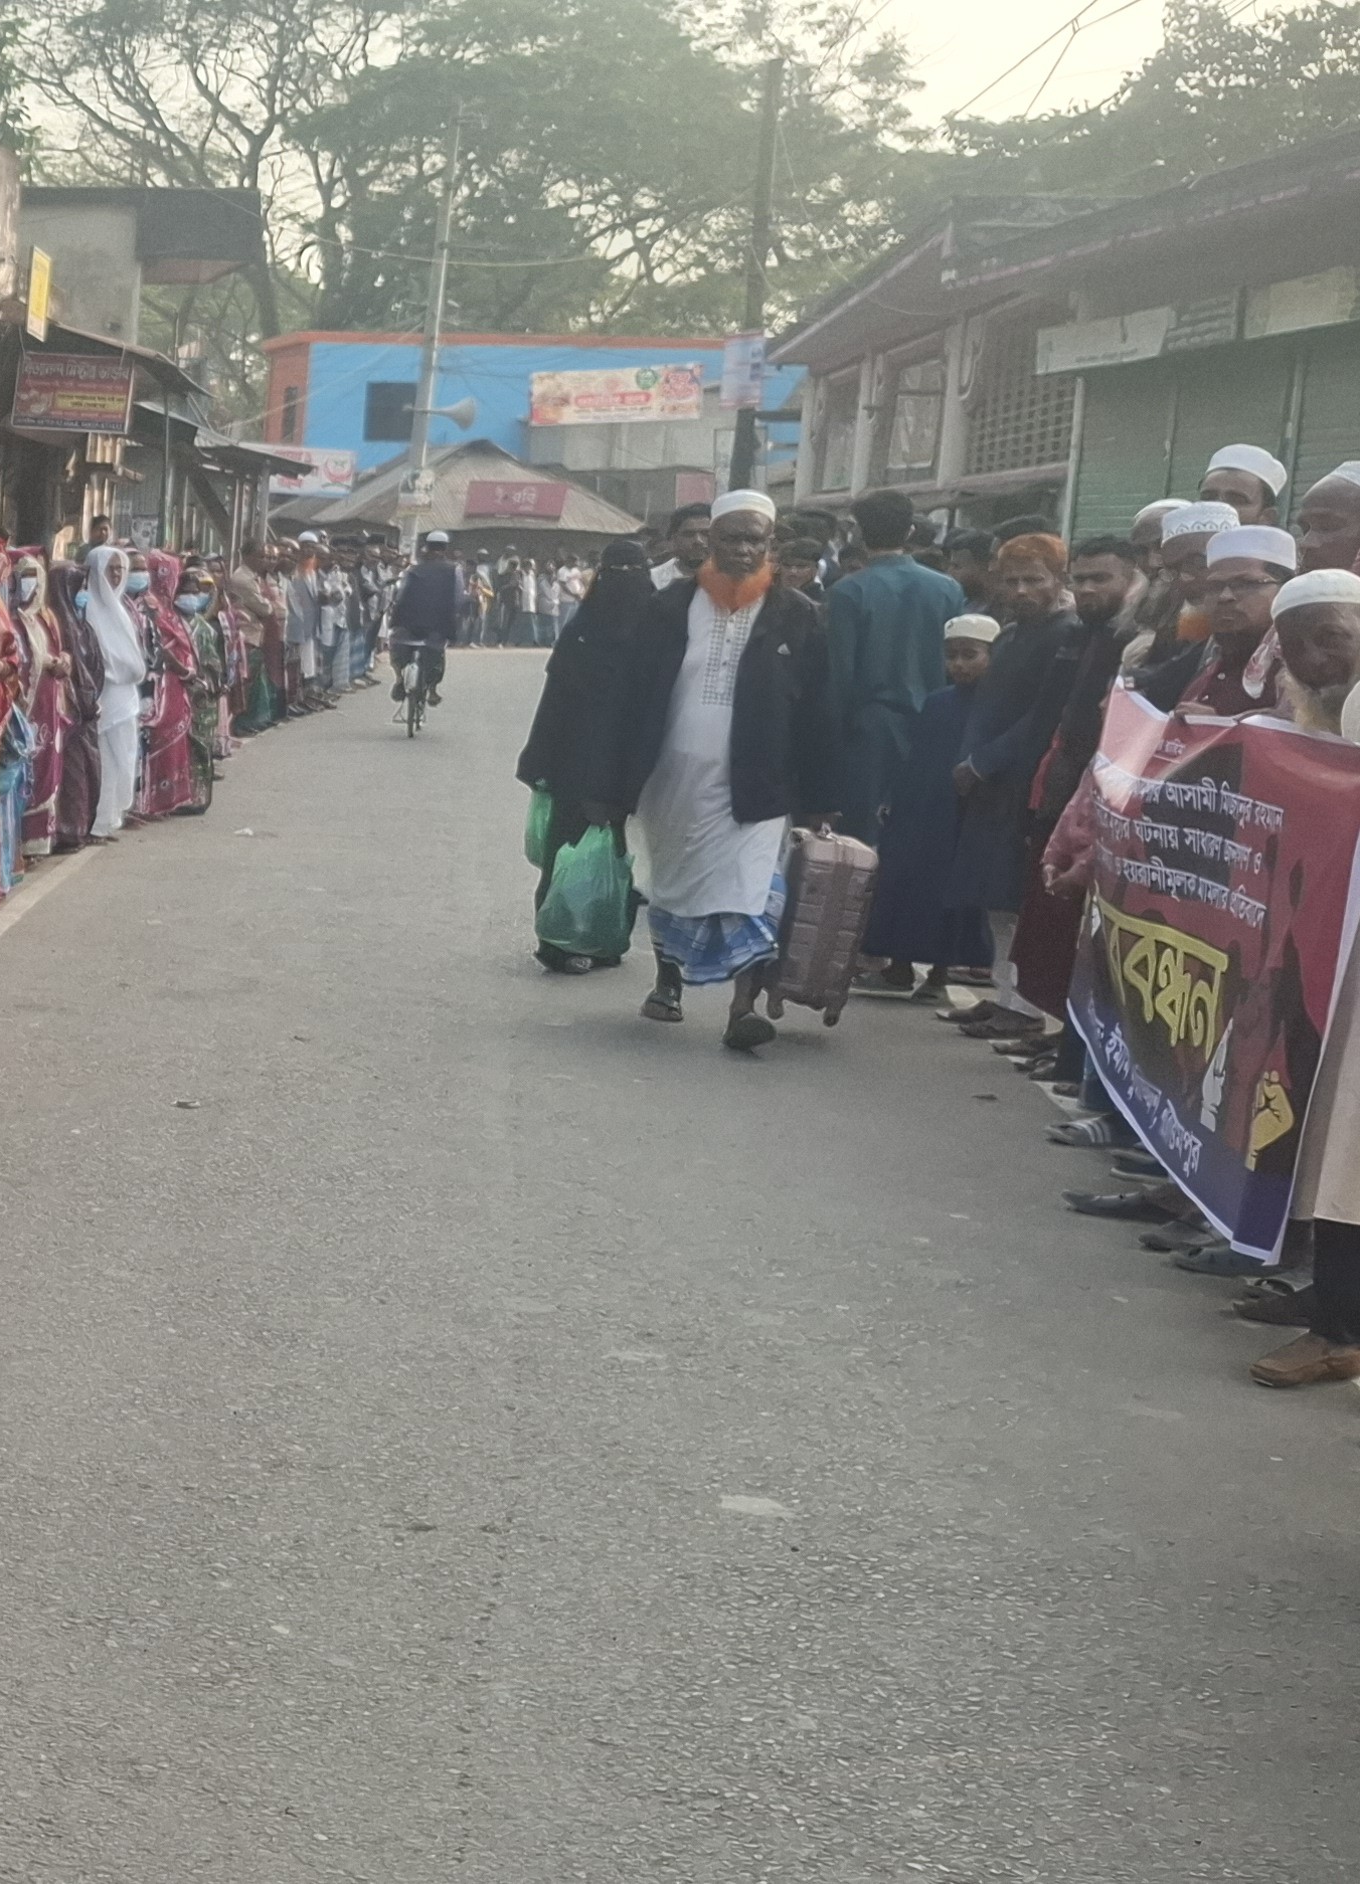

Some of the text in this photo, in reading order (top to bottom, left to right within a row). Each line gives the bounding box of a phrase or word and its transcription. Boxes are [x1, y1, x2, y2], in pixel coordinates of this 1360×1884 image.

[1165, 776, 1218, 812] আসামী
[1133, 816, 1180, 850] ঘটনায়
[1254, 852, 1263, 874] ও
[1122, 855, 1197, 902] হয়রানীমূলক
